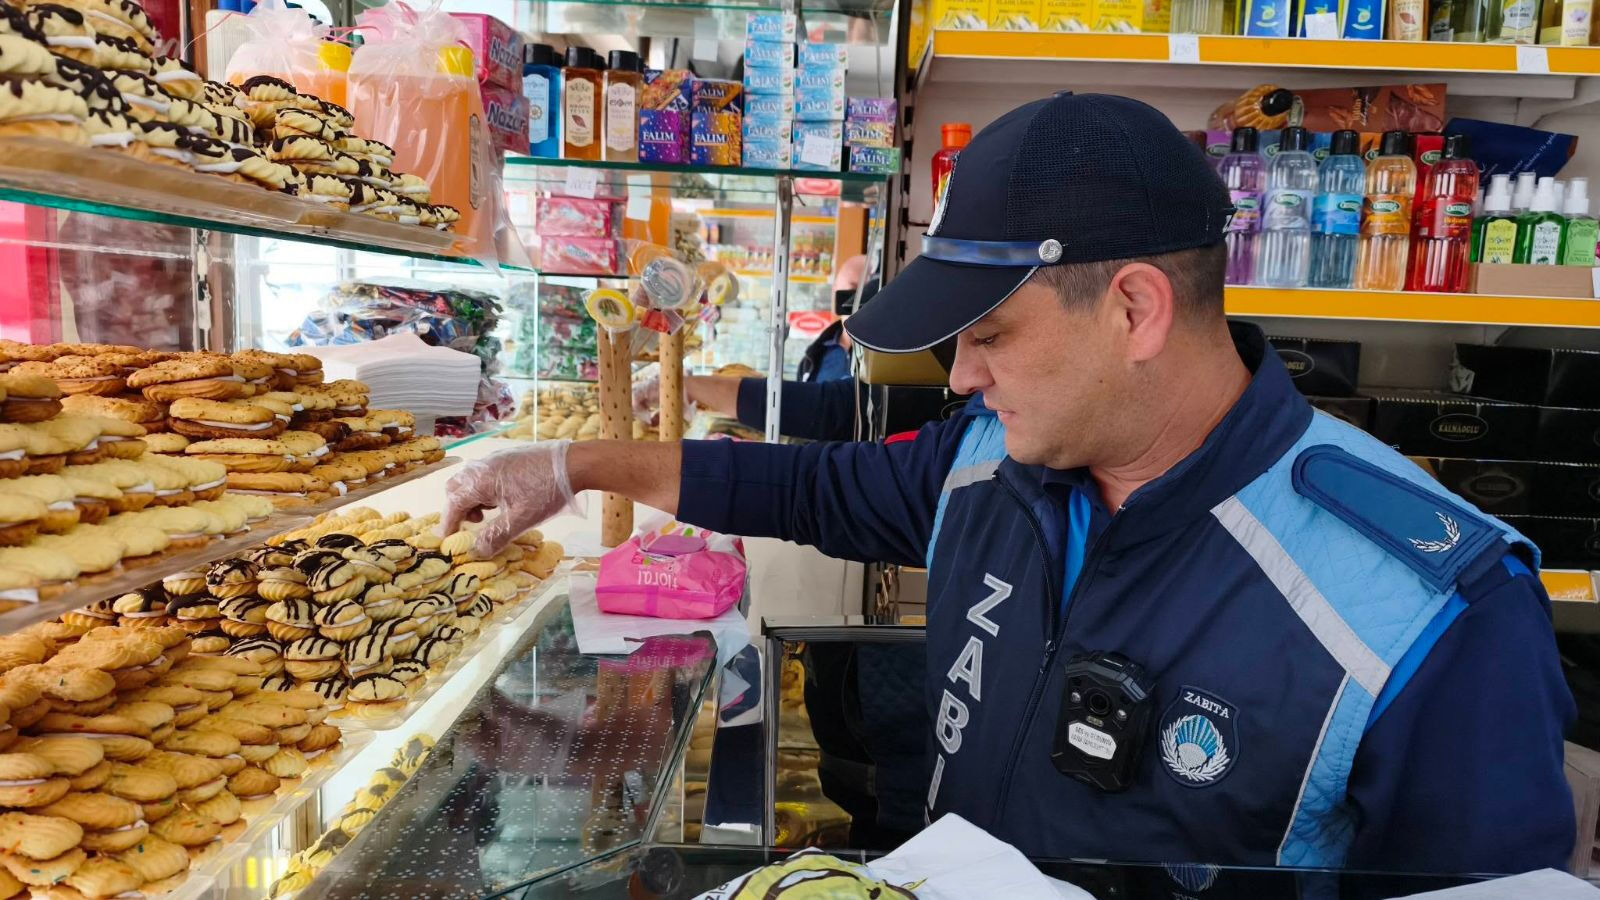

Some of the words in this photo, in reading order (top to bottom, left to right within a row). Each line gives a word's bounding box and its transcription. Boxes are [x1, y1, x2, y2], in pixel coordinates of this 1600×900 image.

[642, 131, 674, 141] FALIM
[694, 133, 726, 143] FALIM
[638, 570, 679, 591] floral
[924, 572, 1013, 827] ZABI
[1183, 691, 1230, 719] ZABITA
